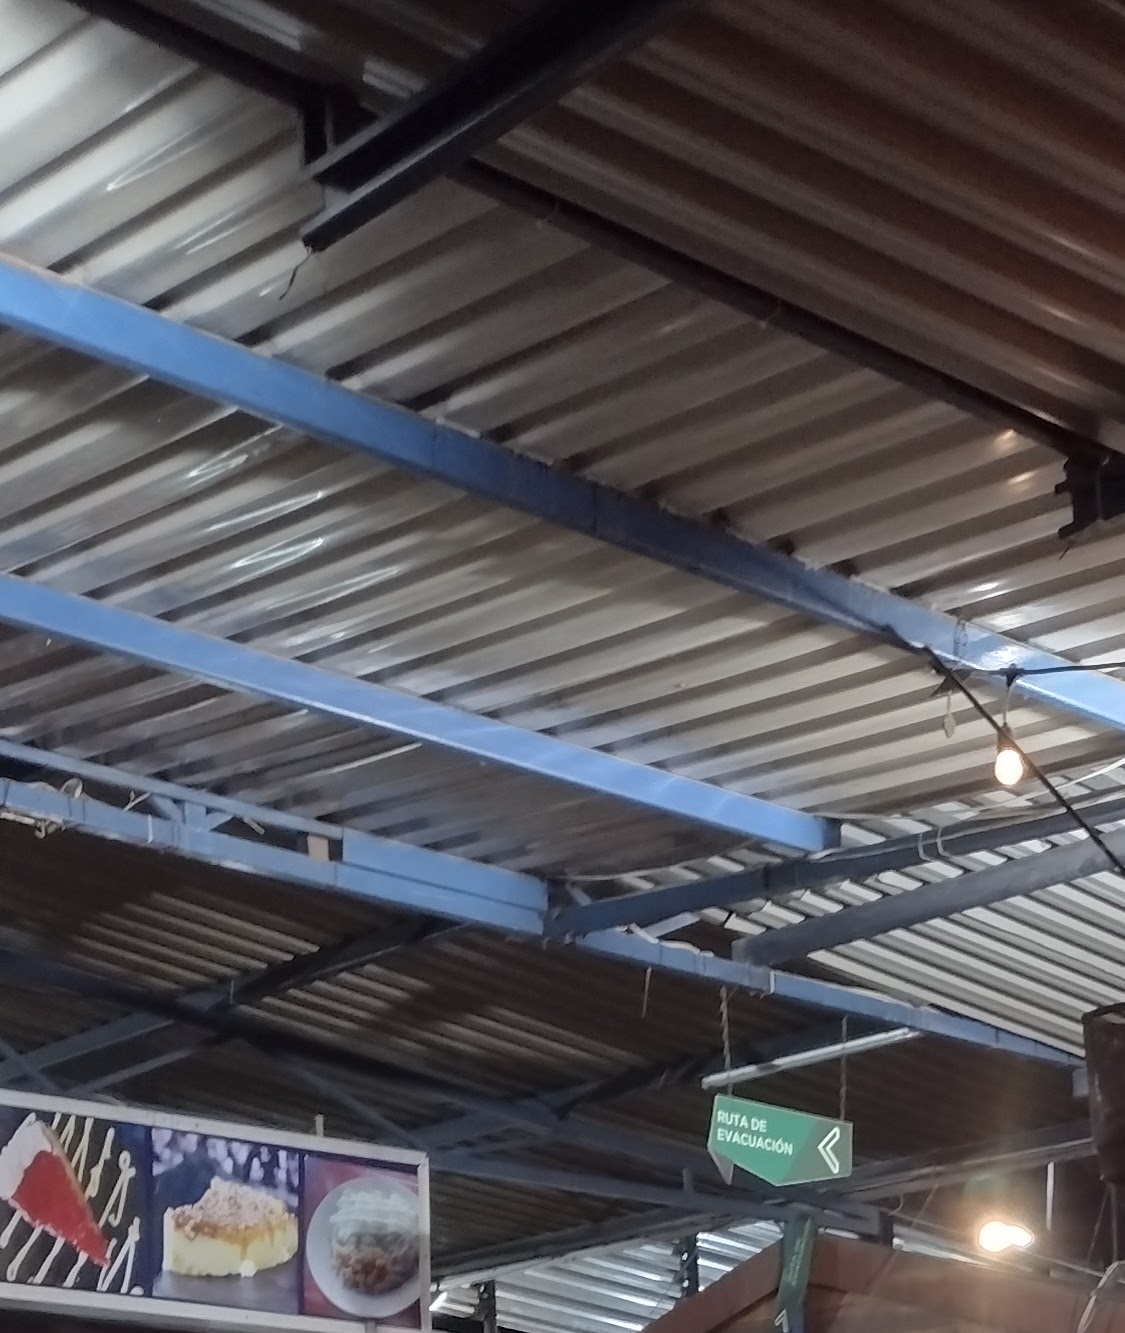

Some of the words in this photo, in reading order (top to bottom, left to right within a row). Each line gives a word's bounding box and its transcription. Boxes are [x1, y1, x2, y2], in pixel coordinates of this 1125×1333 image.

[717, 1109, 748, 1129] RUTA
[751, 1117, 767, 1132] DE
[717, 1128, 794, 1156] EVACUACIÓN
